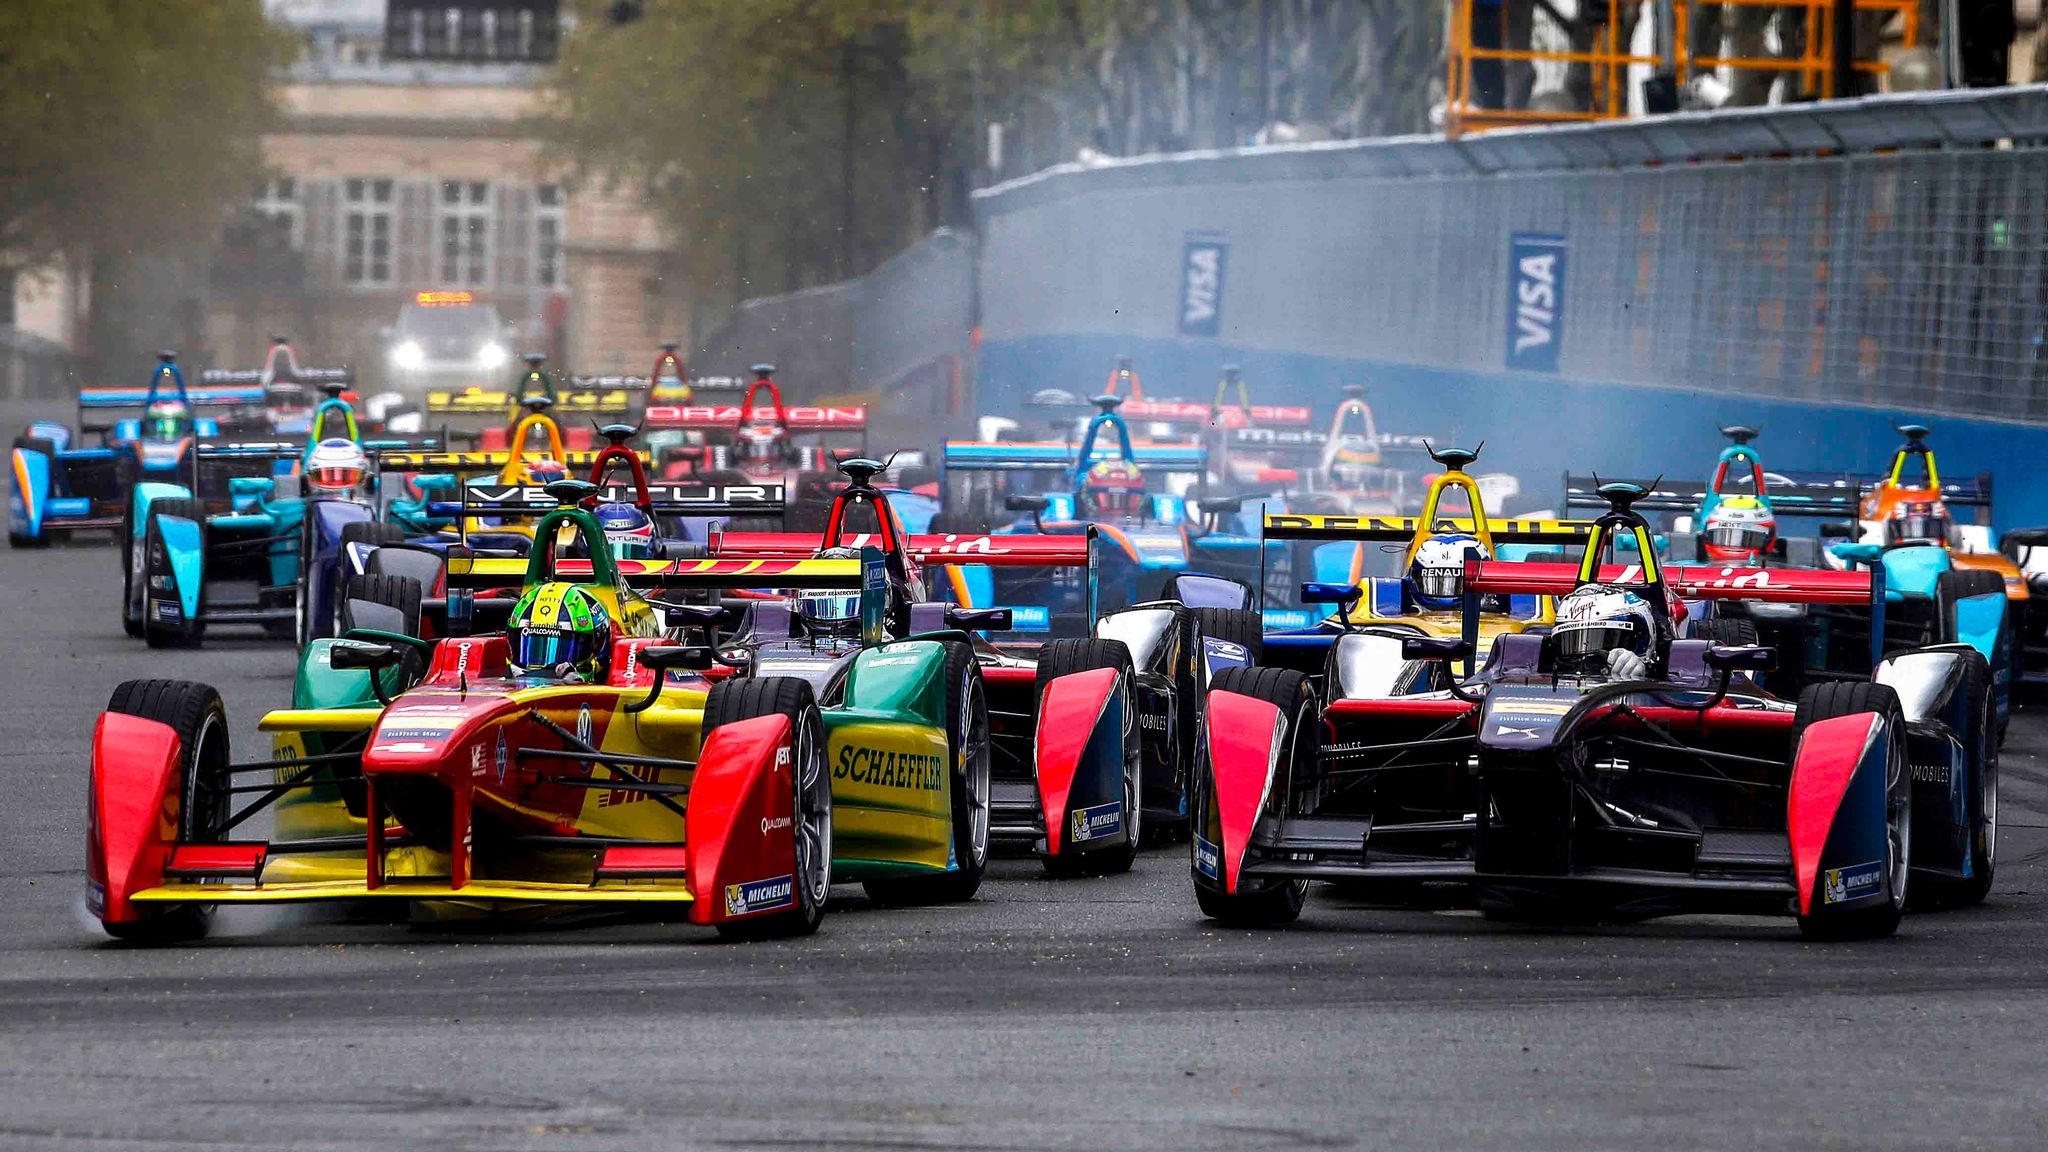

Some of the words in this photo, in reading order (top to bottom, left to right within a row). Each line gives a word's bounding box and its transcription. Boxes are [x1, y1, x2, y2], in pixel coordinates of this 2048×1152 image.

[1184, 249, 1219, 322] VISA
[1514, 253, 1556, 356] VISA
[571, 375, 744, 388] VENURI
[646, 407, 864, 422] DRAGON
[1569, 598, 1597, 620] Virgin
[521, 627, 561, 637] QUALCOMM
[774, 746, 792, 772] ABT
[833, 744, 942, 792] SCHAEFFLER
[1909, 764, 1950, 784] MOBILES
[760, 817, 792, 837] QUALCOMM
[1091, 811, 1120, 828] MICHELIN
[1847, 870, 1881, 889] MICHELIN
[748, 881, 792, 904] MICHELIN
